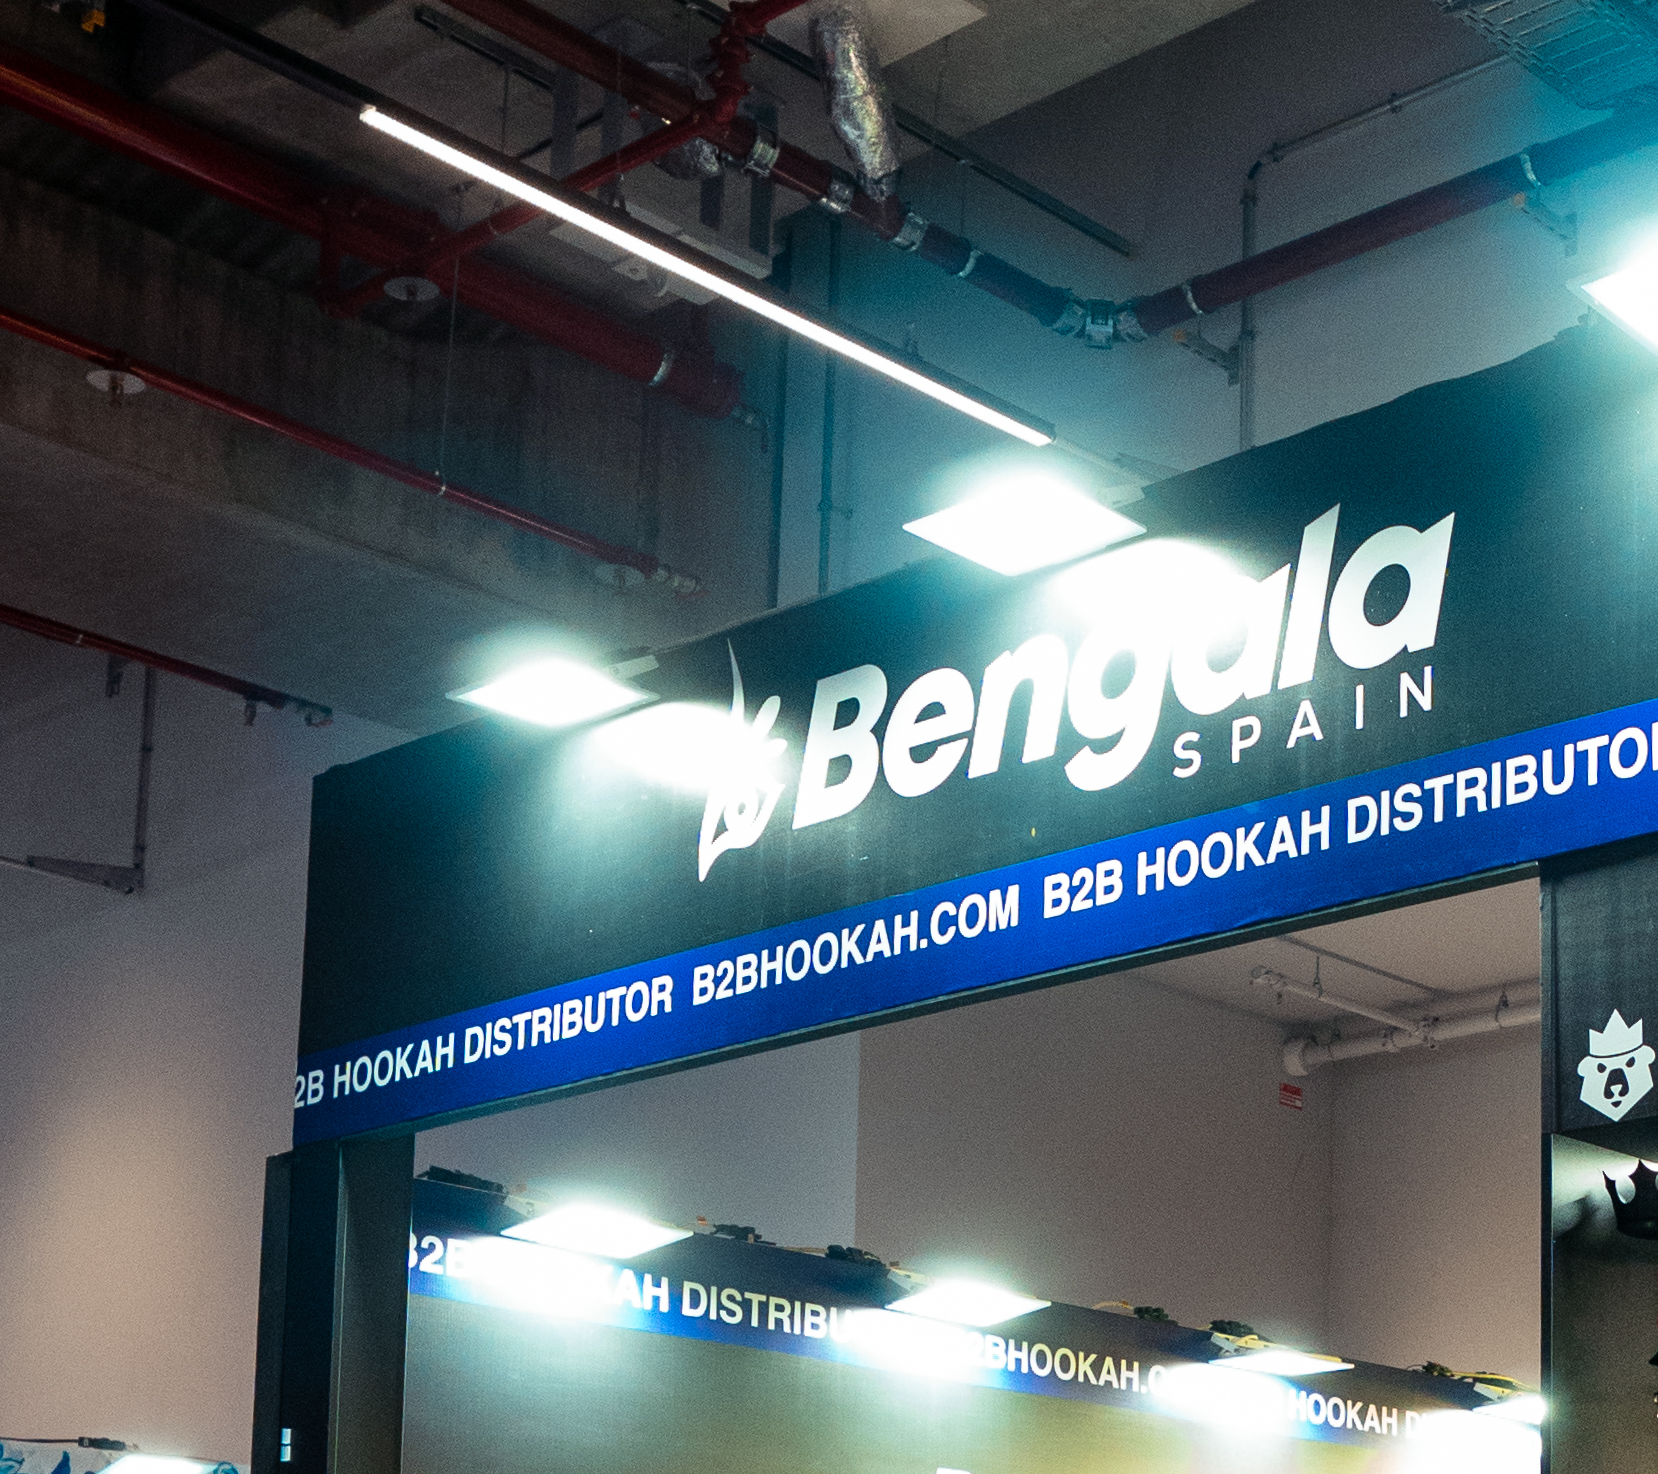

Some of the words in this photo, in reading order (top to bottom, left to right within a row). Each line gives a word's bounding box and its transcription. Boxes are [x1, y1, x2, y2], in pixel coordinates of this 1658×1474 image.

[791, 503, 1455, 791] Bengala
[1172, 664, 1434, 780] SPAIN
[293, 1069, 324, 1109] 2B
[333, 1032, 456, 1099] HOOKAH
[463, 975, 674, 1065] DISTRIBUTOR
[692, 884, 1020, 1006] B2BHOOKAH.COM
[1042, 858, 1123, 919] B2B
[1135, 805, 1332, 896] HOOKAH
[1288, 1388, 1398, 1436] HOOKAH
